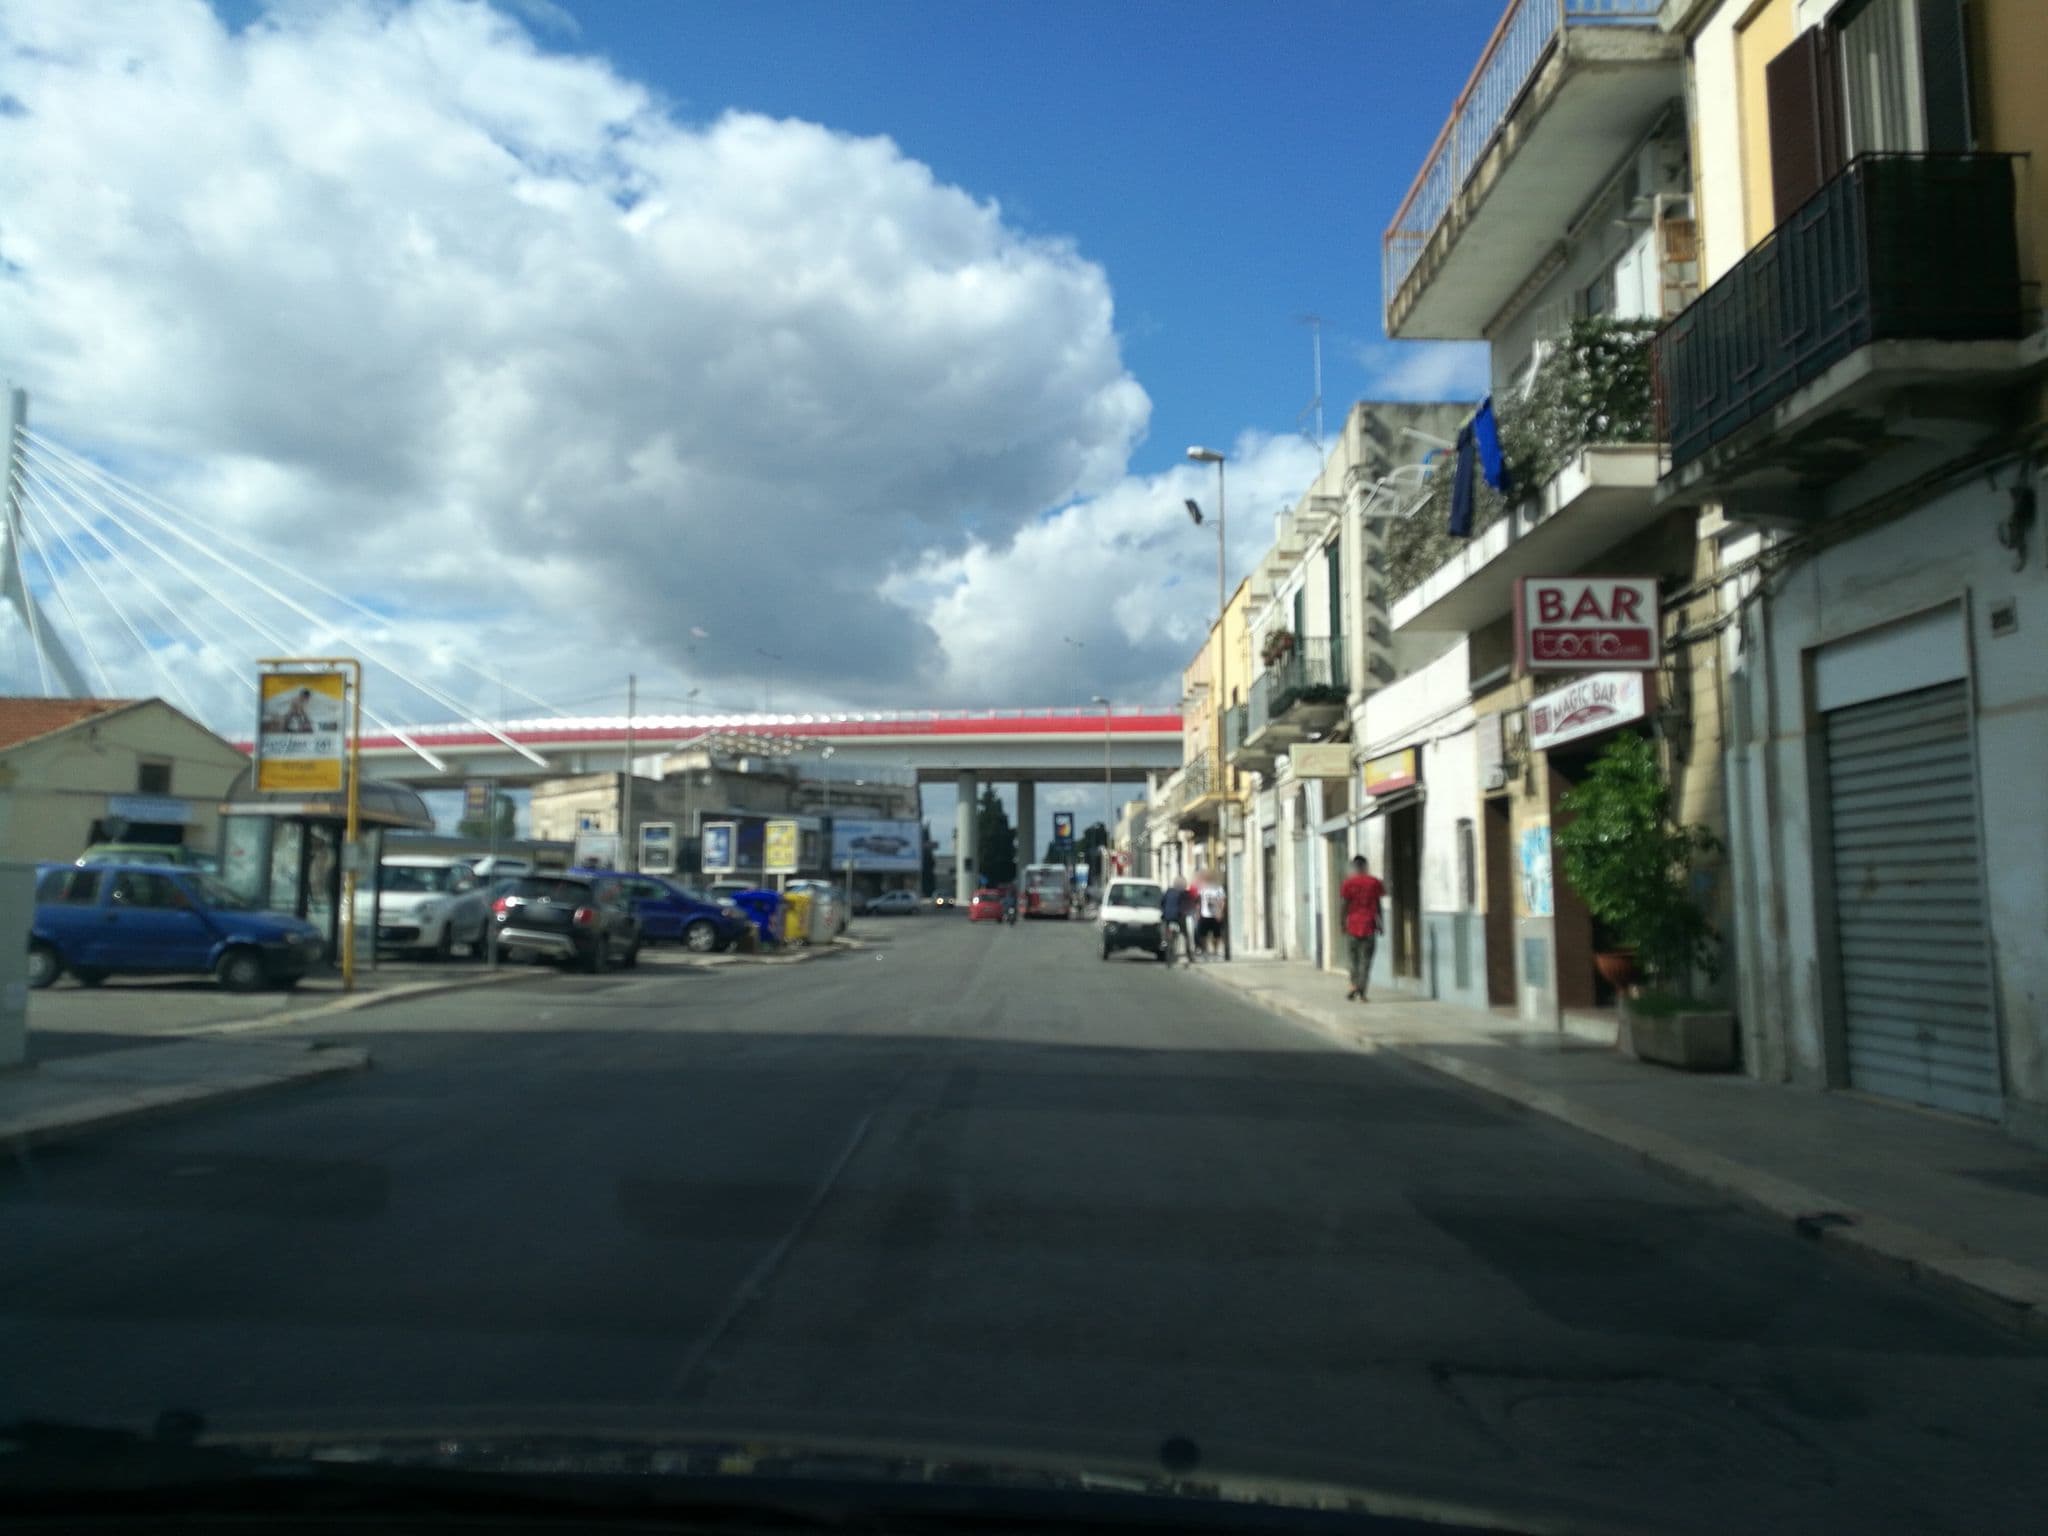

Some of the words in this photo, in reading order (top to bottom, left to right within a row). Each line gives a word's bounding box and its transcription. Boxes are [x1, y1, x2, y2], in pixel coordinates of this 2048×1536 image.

[1538, 584, 1643, 624] BAR
[1553, 684, 1589, 718] MAGIC
[1591, 679, 1616, 706] BAR
